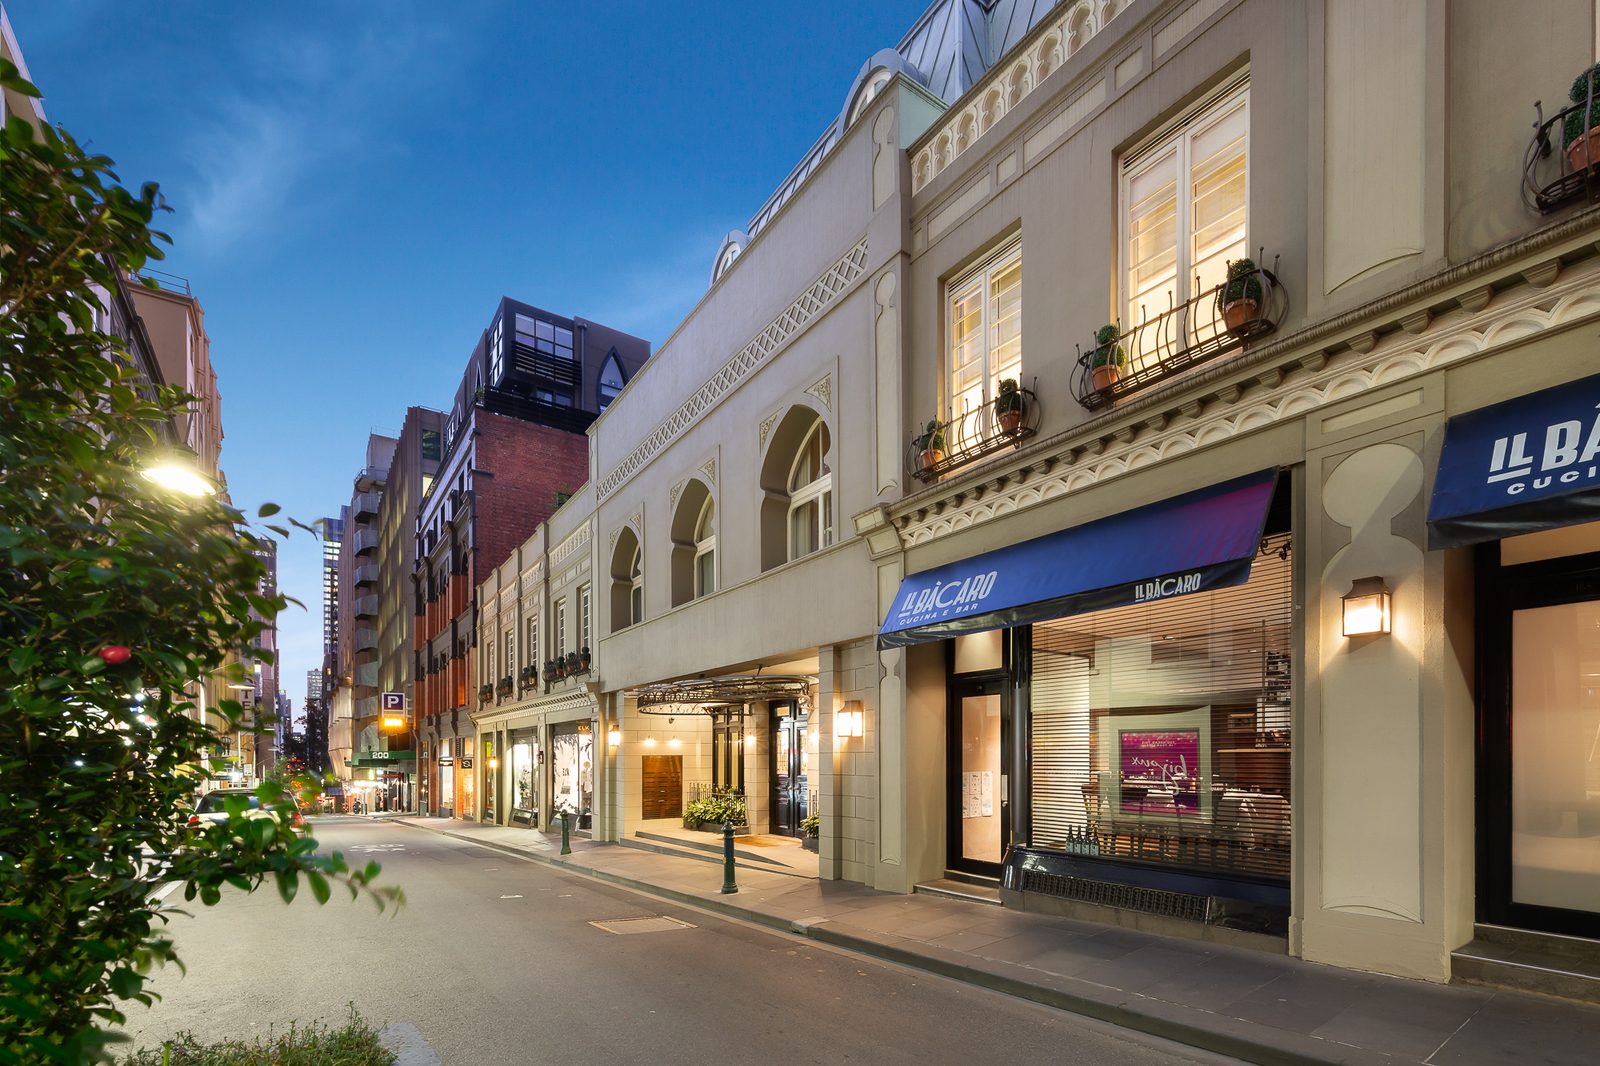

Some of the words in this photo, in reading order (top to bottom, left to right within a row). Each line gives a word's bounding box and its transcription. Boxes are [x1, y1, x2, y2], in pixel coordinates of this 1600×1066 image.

[1488, 432, 1533, 478] IL
[901, 592, 917, 614] IL
[1135, 585, 1144, 600] IL
[900, 612, 937, 625] CUCINA
[955, 603, 978, 613] BAR
[387, 696, 399, 709] P
